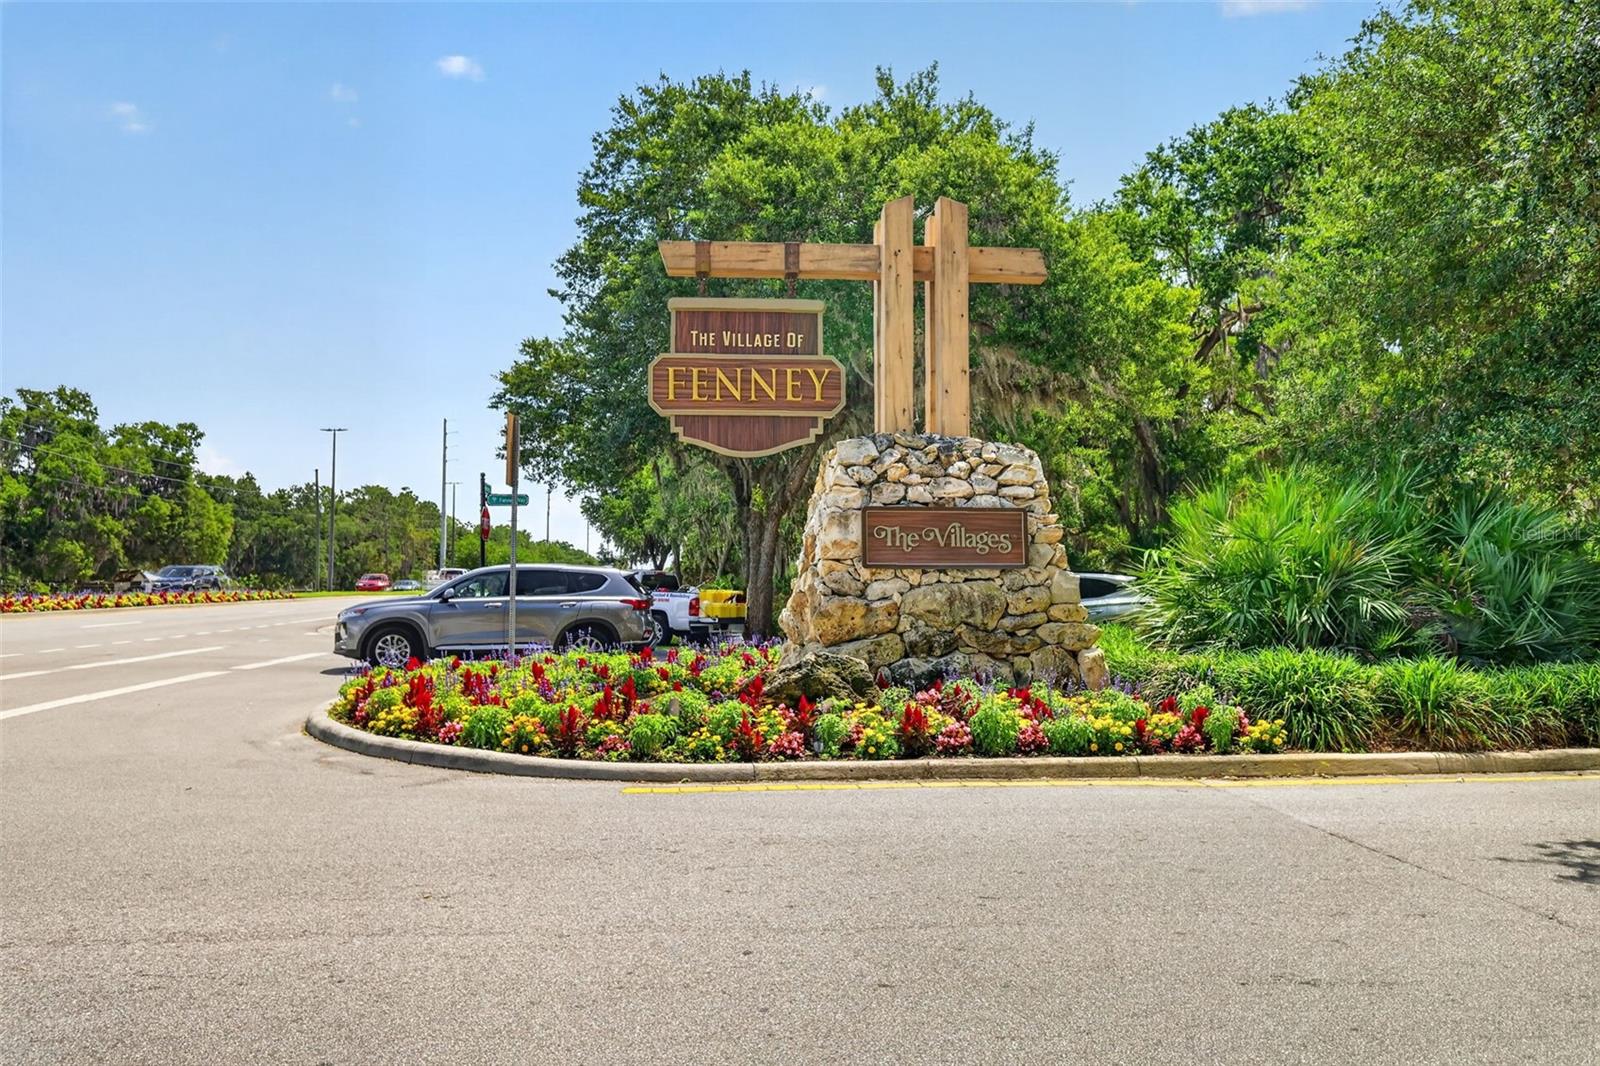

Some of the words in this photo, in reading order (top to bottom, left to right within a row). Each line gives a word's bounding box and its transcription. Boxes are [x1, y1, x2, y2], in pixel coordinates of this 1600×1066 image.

[690, 330, 716, 347] THE
[722, 330, 781, 348] VILLAGE
[787, 332, 804, 348] OF
[666, 367, 832, 402] FENNEY
[873, 525, 920, 552] The
[922, 522, 1012, 554] Villages
